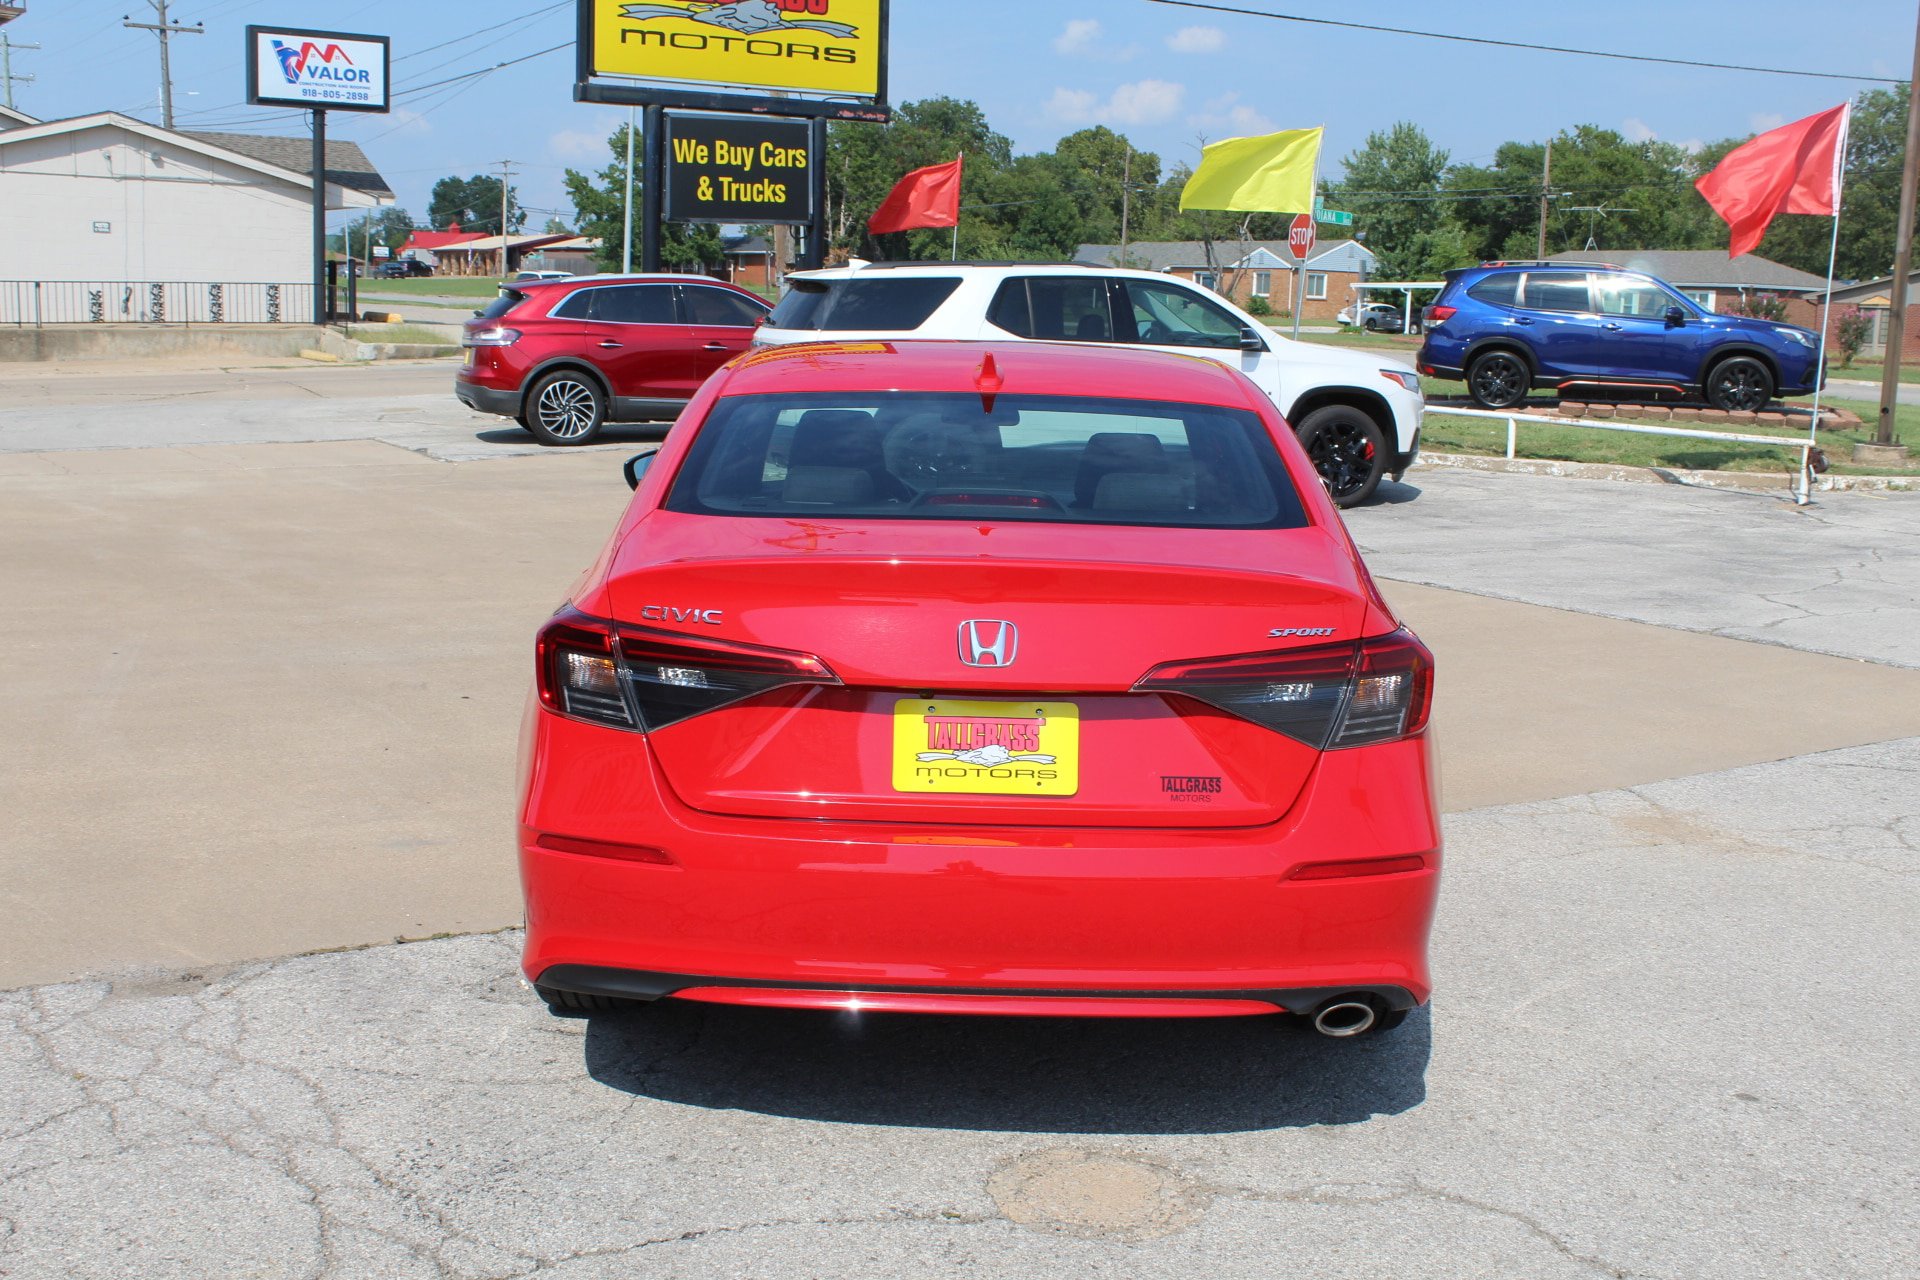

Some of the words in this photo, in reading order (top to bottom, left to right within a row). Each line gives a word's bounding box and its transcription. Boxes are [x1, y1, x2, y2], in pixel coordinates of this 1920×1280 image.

[620, 28, 857, 64] MOTORS
[306, 65, 370, 83] VALOR
[302, 88, 369, 100] 918-805-2898
[673, 138, 709, 165] We
[715, 140, 755, 172] Buy
[760, 142, 807, 168] Cars
[697, 176, 714, 202] &
[718, 176, 786, 203] Trucks
[1290, 227, 1313, 245] STOP
[641, 605, 723, 625] CIVIC
[1267, 627, 1336, 638] SPORT
[924, 716, 1046, 752] TALLGRASS
[916, 767, 1058, 779] MOTORS
[1160, 775, 1222, 793] TALLGRASS
[1170, 794, 1211, 803] MOTORS
